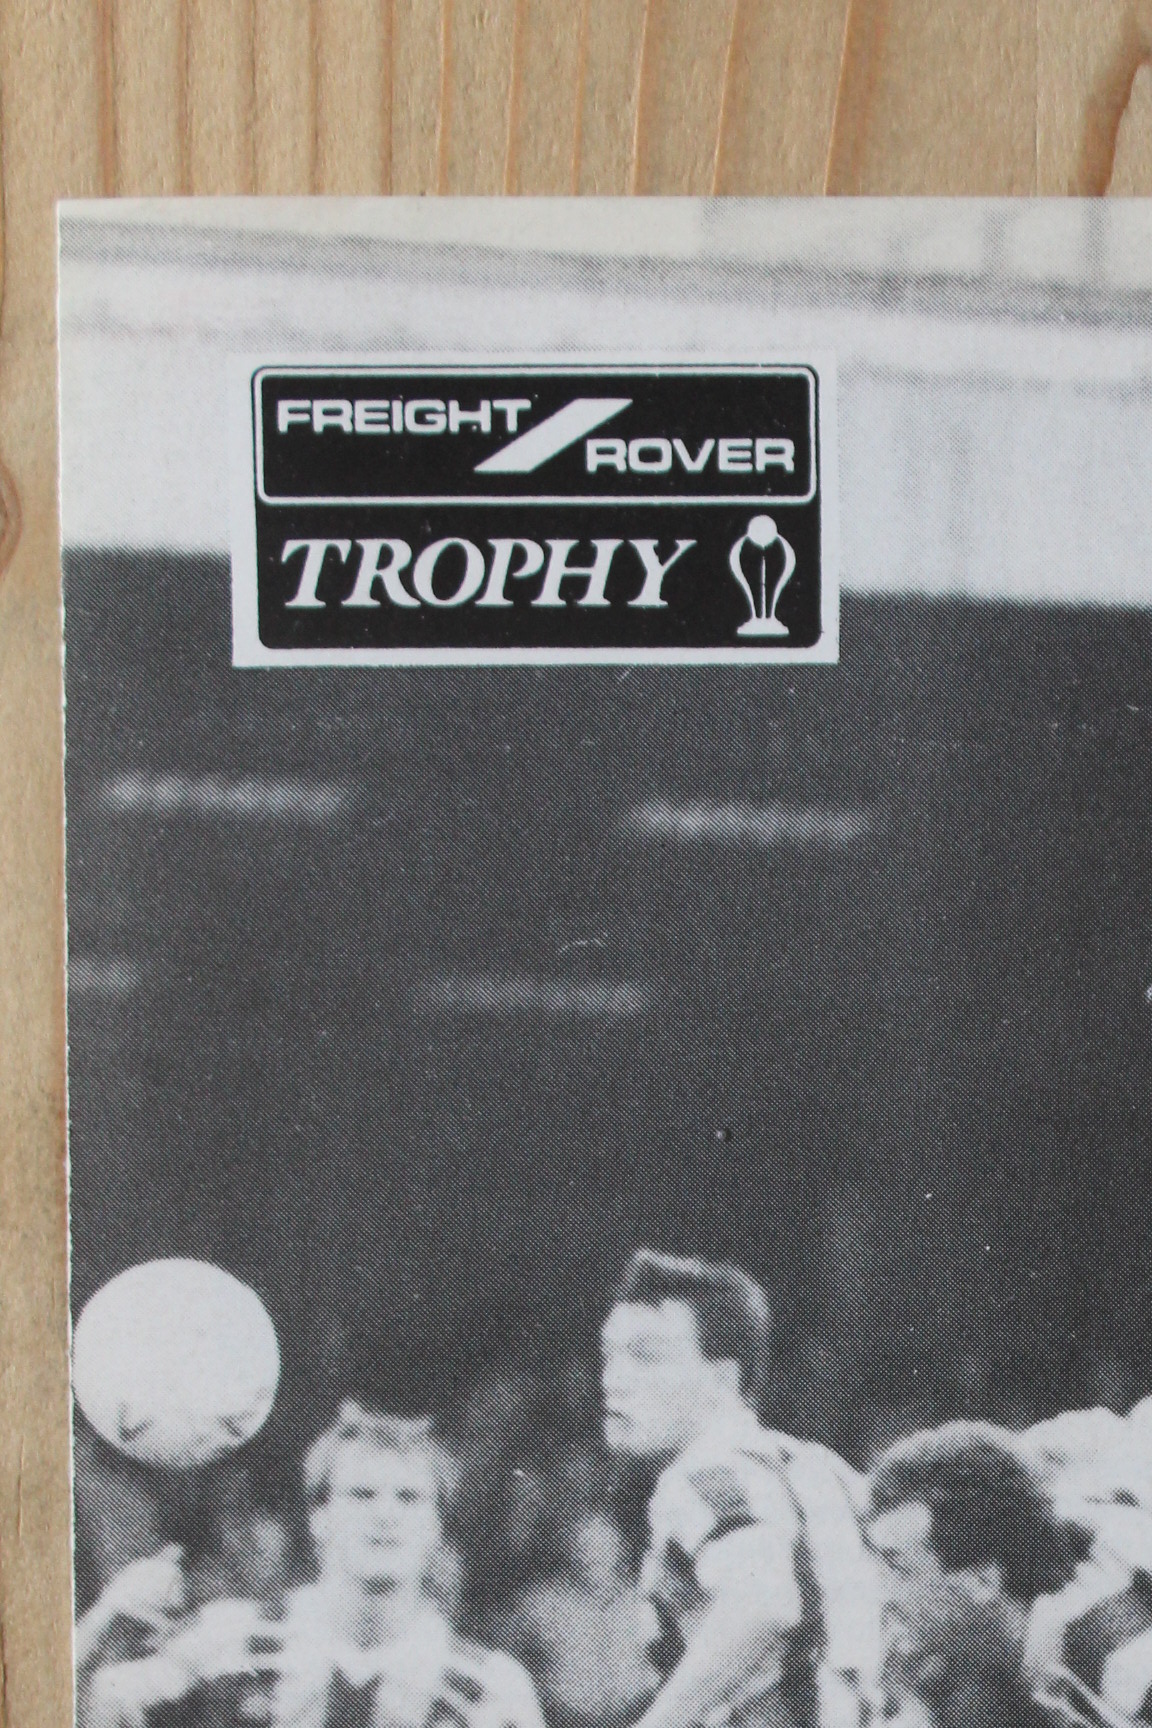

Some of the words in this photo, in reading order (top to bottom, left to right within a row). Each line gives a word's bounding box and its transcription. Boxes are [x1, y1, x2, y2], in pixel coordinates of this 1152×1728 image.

[277, 399, 531, 434] FREIGHT
[586, 438, 794, 473] ROVER
[281, 538, 696, 608] TROPHY
